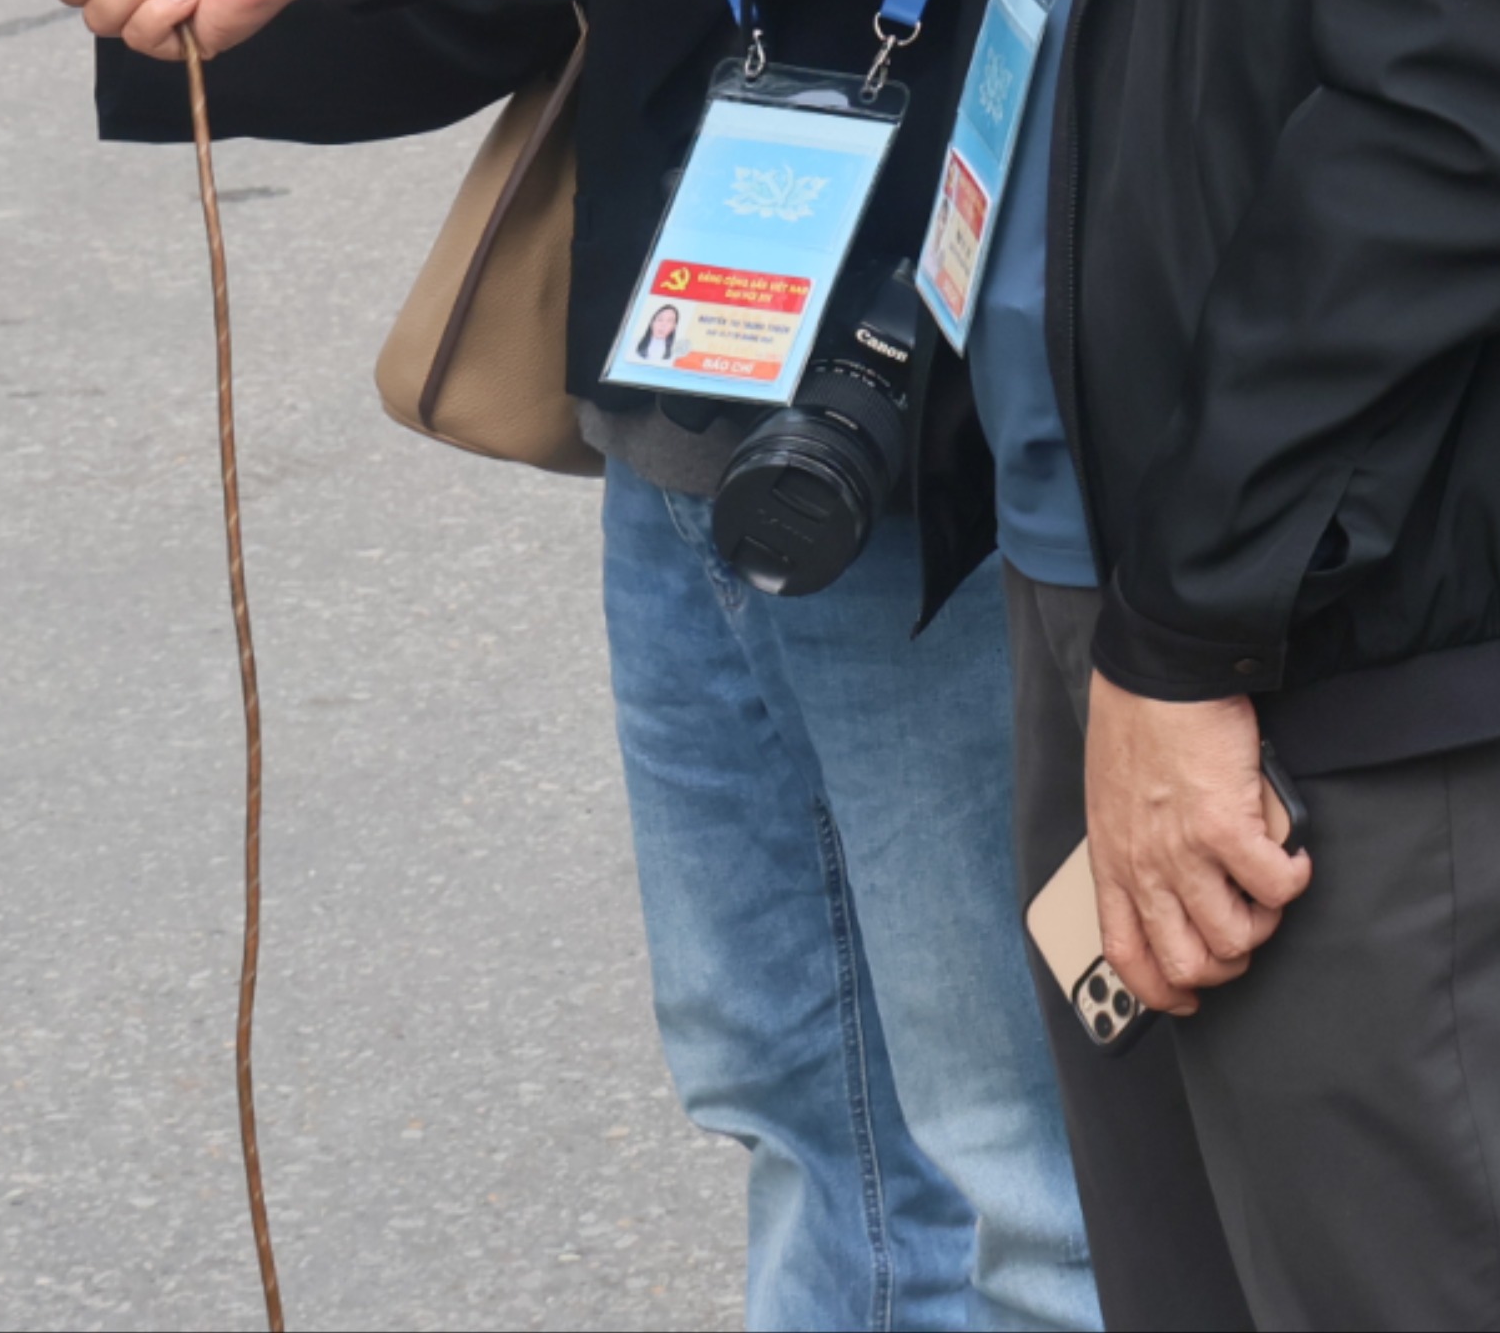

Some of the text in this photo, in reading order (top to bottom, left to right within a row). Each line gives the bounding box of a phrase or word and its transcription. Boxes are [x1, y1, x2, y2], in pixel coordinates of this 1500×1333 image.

[855, 328, 908, 363] Canon
[703, 356, 755, 374] BÁO CHÍ
